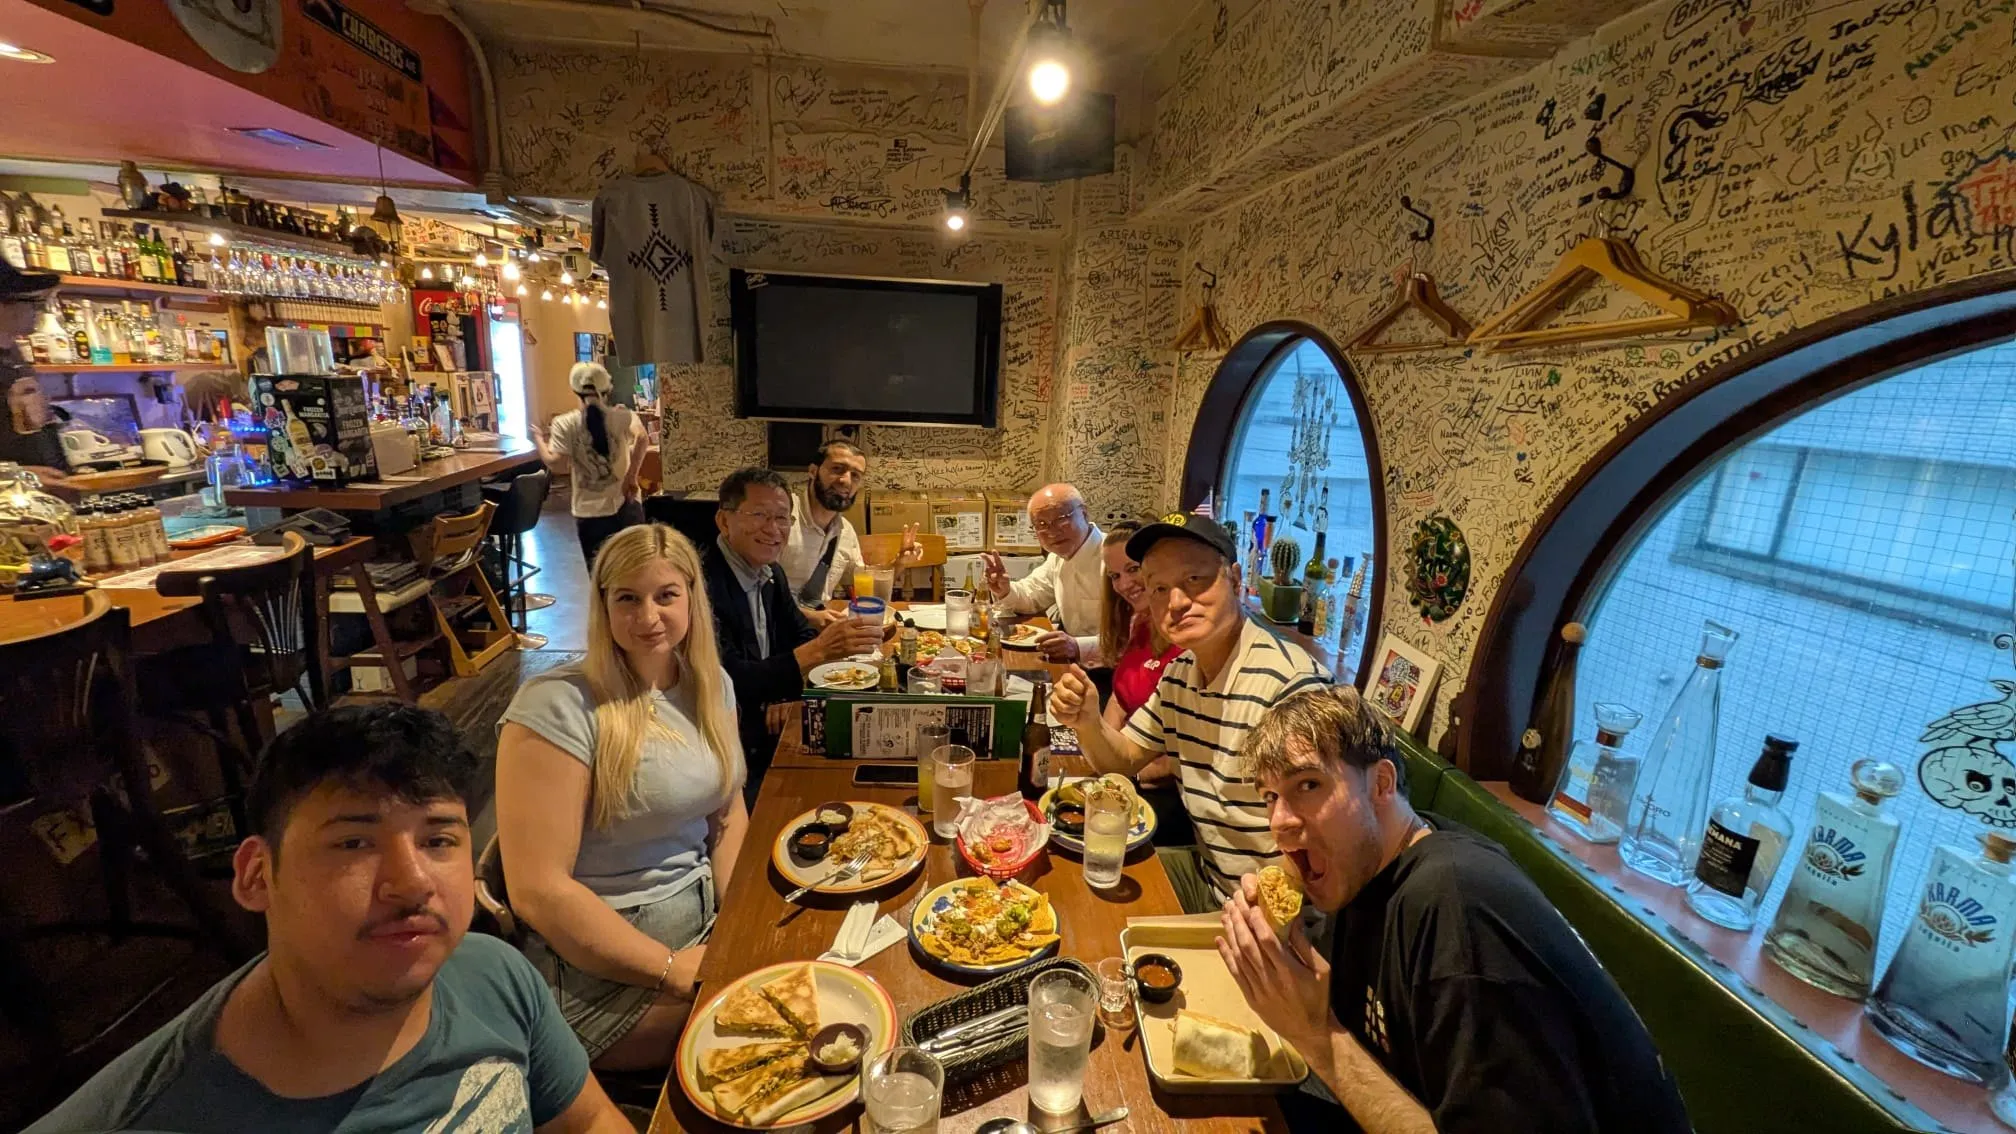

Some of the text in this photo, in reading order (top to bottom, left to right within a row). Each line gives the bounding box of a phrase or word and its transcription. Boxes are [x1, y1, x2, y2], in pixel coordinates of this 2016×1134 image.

[342, 11, 404, 69] CHARGERS
[1835, 180, 1963, 281] Kyla
[1926, 881, 1997, 927] KARMA
